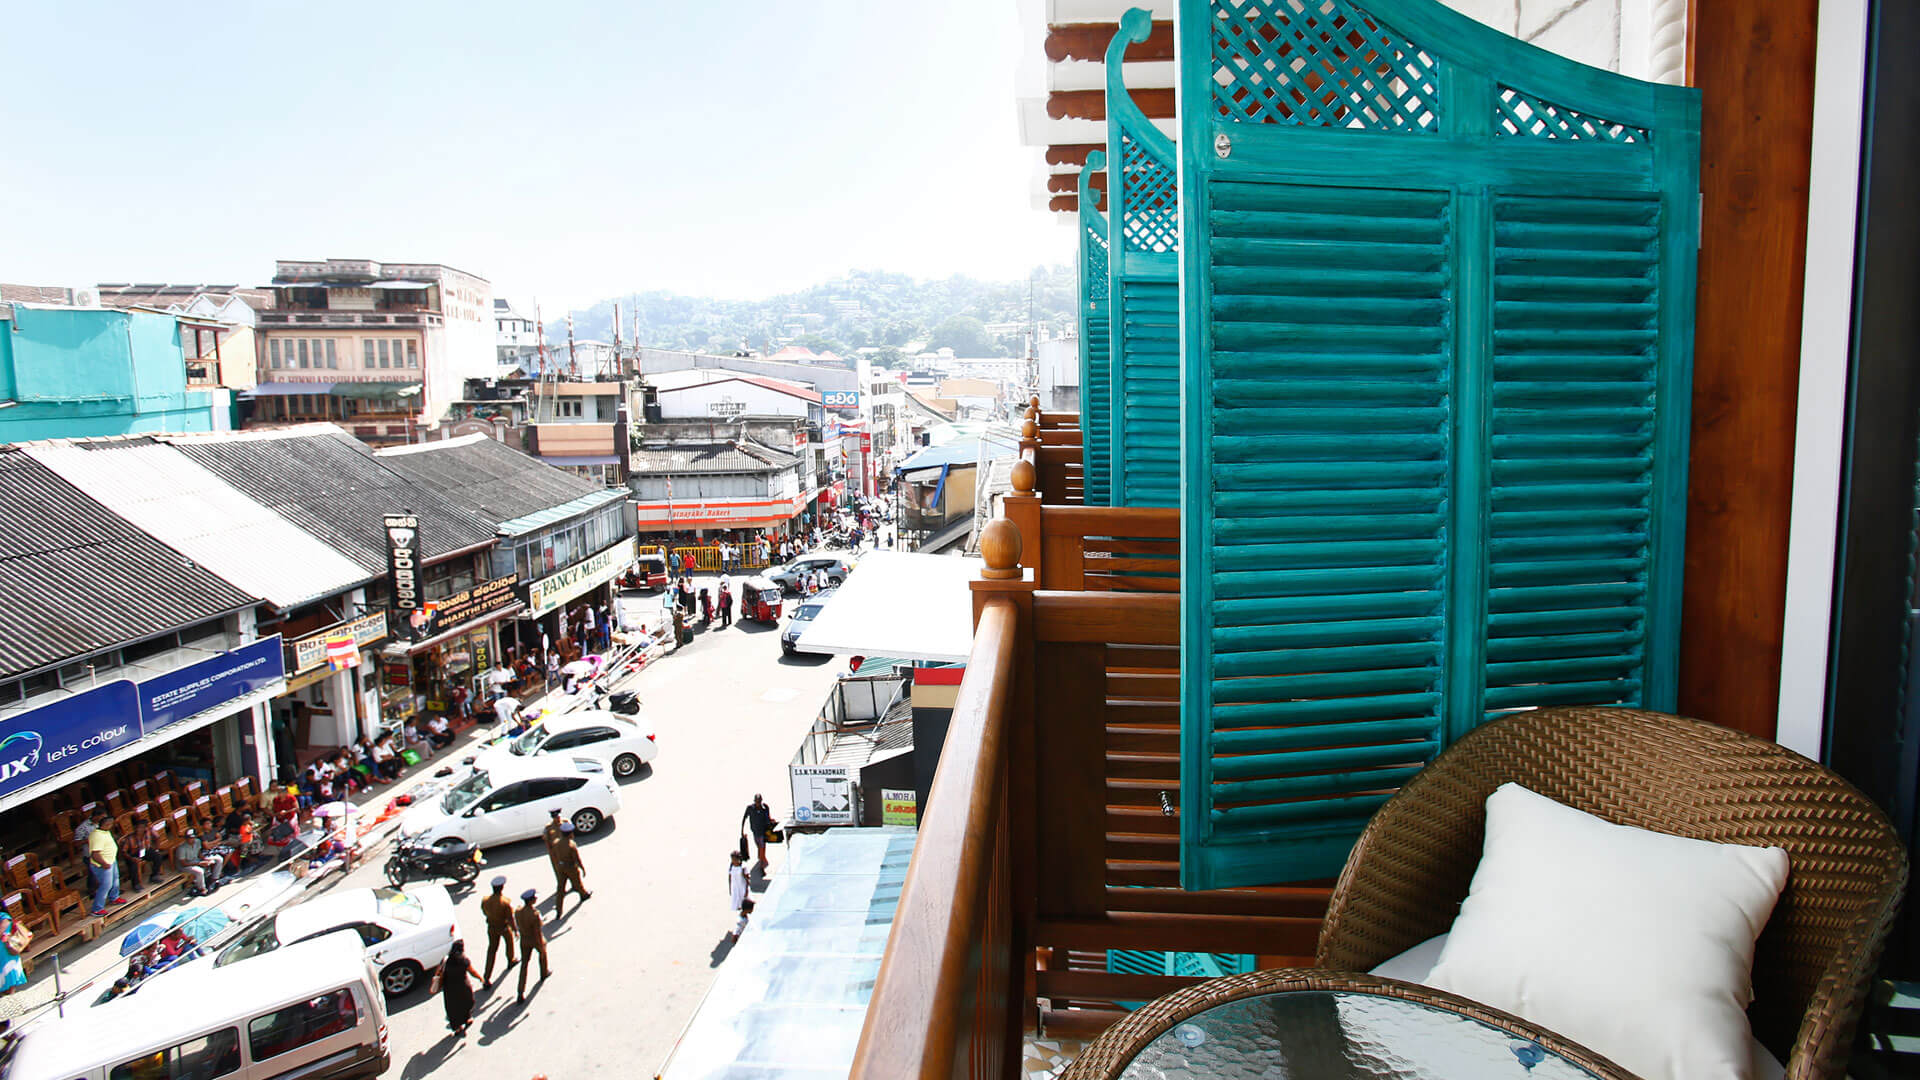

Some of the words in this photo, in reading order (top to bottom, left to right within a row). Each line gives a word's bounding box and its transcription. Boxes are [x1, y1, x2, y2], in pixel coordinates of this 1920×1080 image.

[541, 567, 579, 597] FANCY
[581, 551, 612, 579] MAHAL
[437, 605, 481, 628] SHANTHI
[481, 591, 516, 609] STORES
[152, 686, 179, 704] ESTATE
[179, 678, 210, 694] SUPPLIES
[210, 661, 255, 682] CORPORATION
[81, 723, 128, 749] colour
